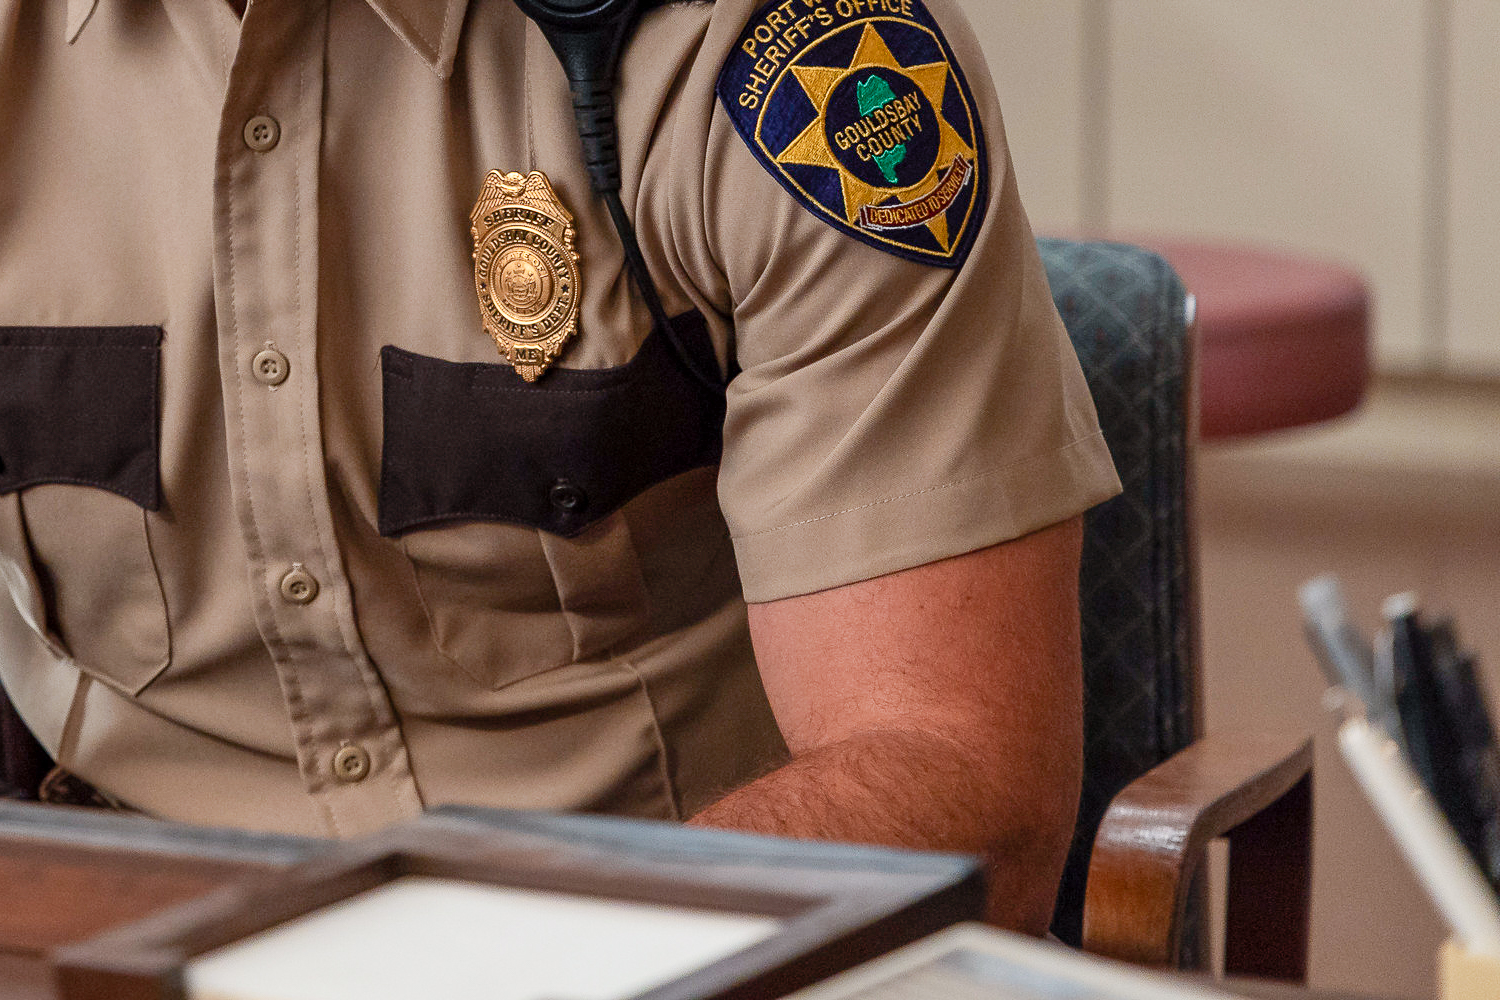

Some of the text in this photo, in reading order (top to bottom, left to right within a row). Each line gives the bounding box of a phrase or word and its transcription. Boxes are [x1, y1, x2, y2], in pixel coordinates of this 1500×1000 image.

[741, 0, 797, 59] PORT
[738, 6, 834, 110] SHERIFF'S
[834, 91, 922, 151] GOULDSBAY
[856, 113, 923, 162] COUNTY
[483, 208, 555, 230] SHERIFF
[870, 166, 966, 225] DEDICATED TO SERVICE
[478, 230, 571, 281] GOULDSBAY COUNTY
[483, 294, 540, 338] SHERIFF'S
[514, 349, 538, 363] ME
